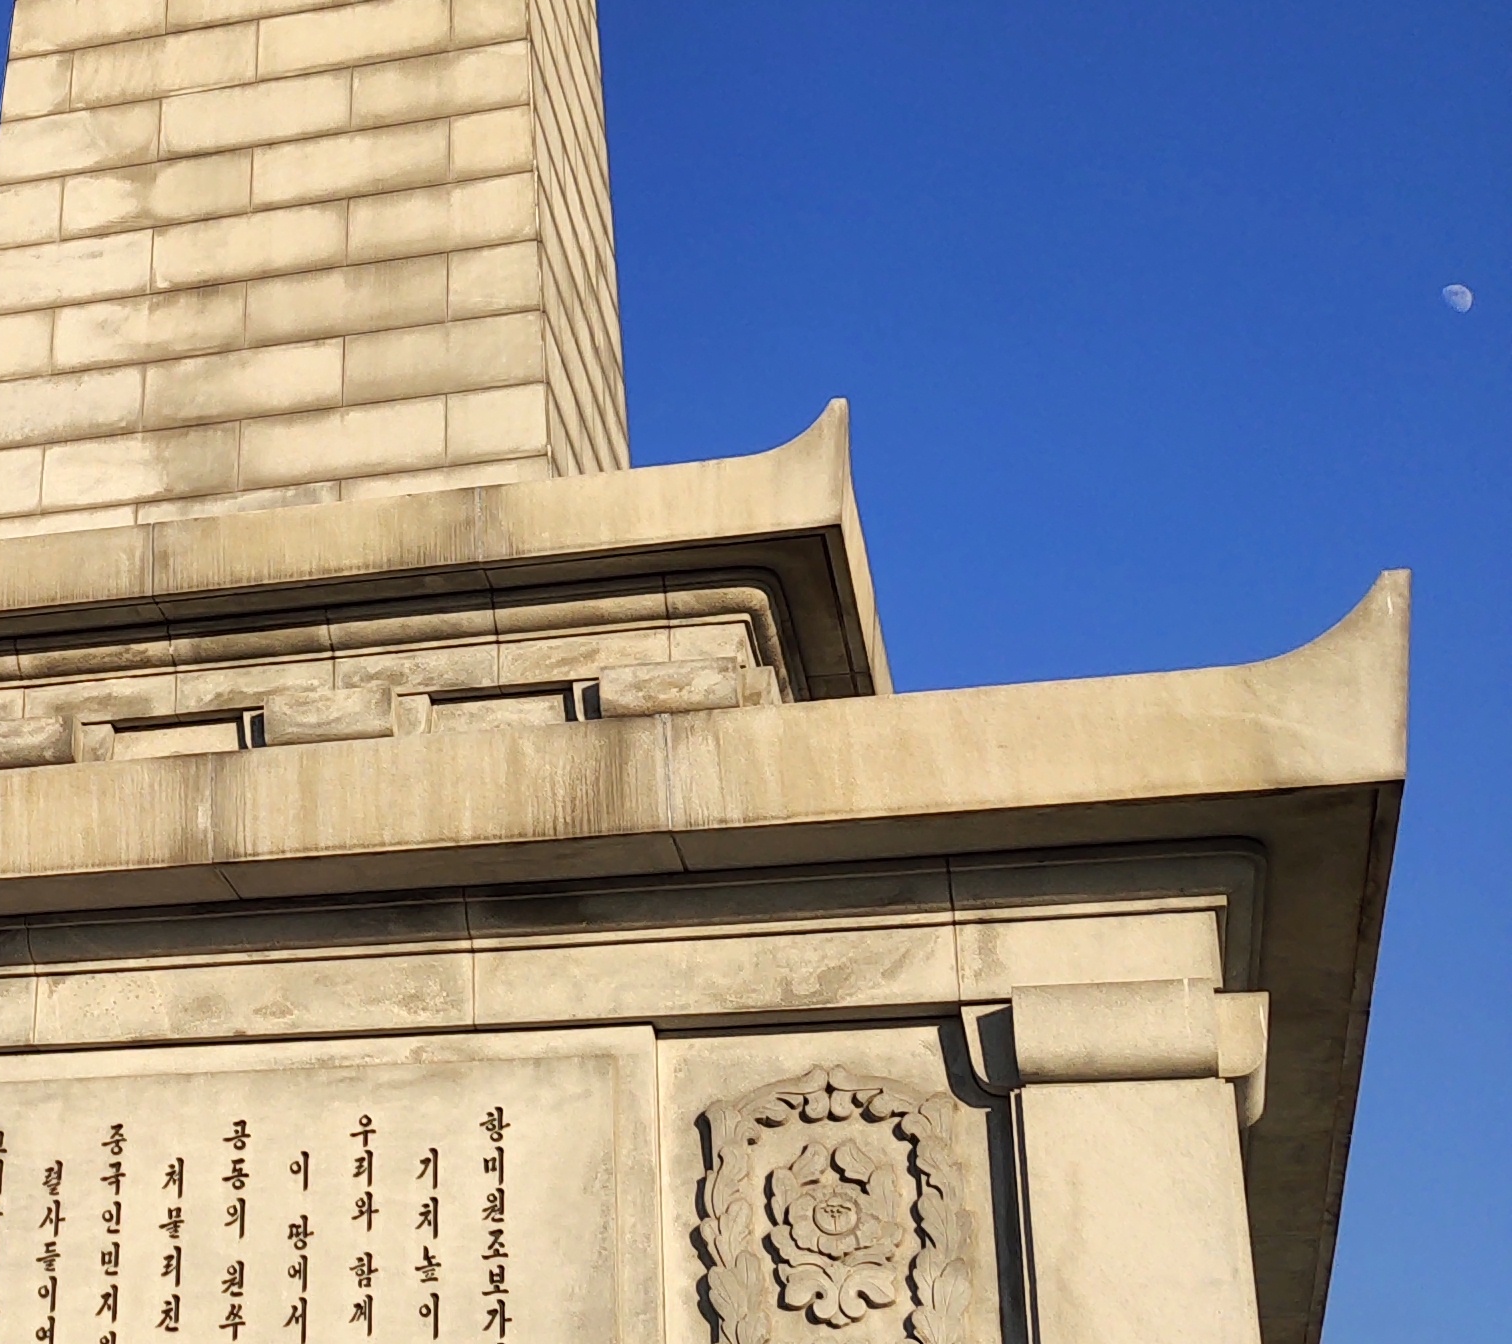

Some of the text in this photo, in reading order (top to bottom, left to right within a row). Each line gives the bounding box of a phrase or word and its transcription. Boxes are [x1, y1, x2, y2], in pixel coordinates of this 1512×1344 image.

[221, 1119, 252, 1239] 공동의
[289, 1150, 310, 1192] 이
[349, 1114, 380, 1232] 우리와
[156, 1157, 185, 1333] 쳐물리친
[349, 1251, 379, 1337] 함께
[414, 1147, 442, 1341] 기치높이
